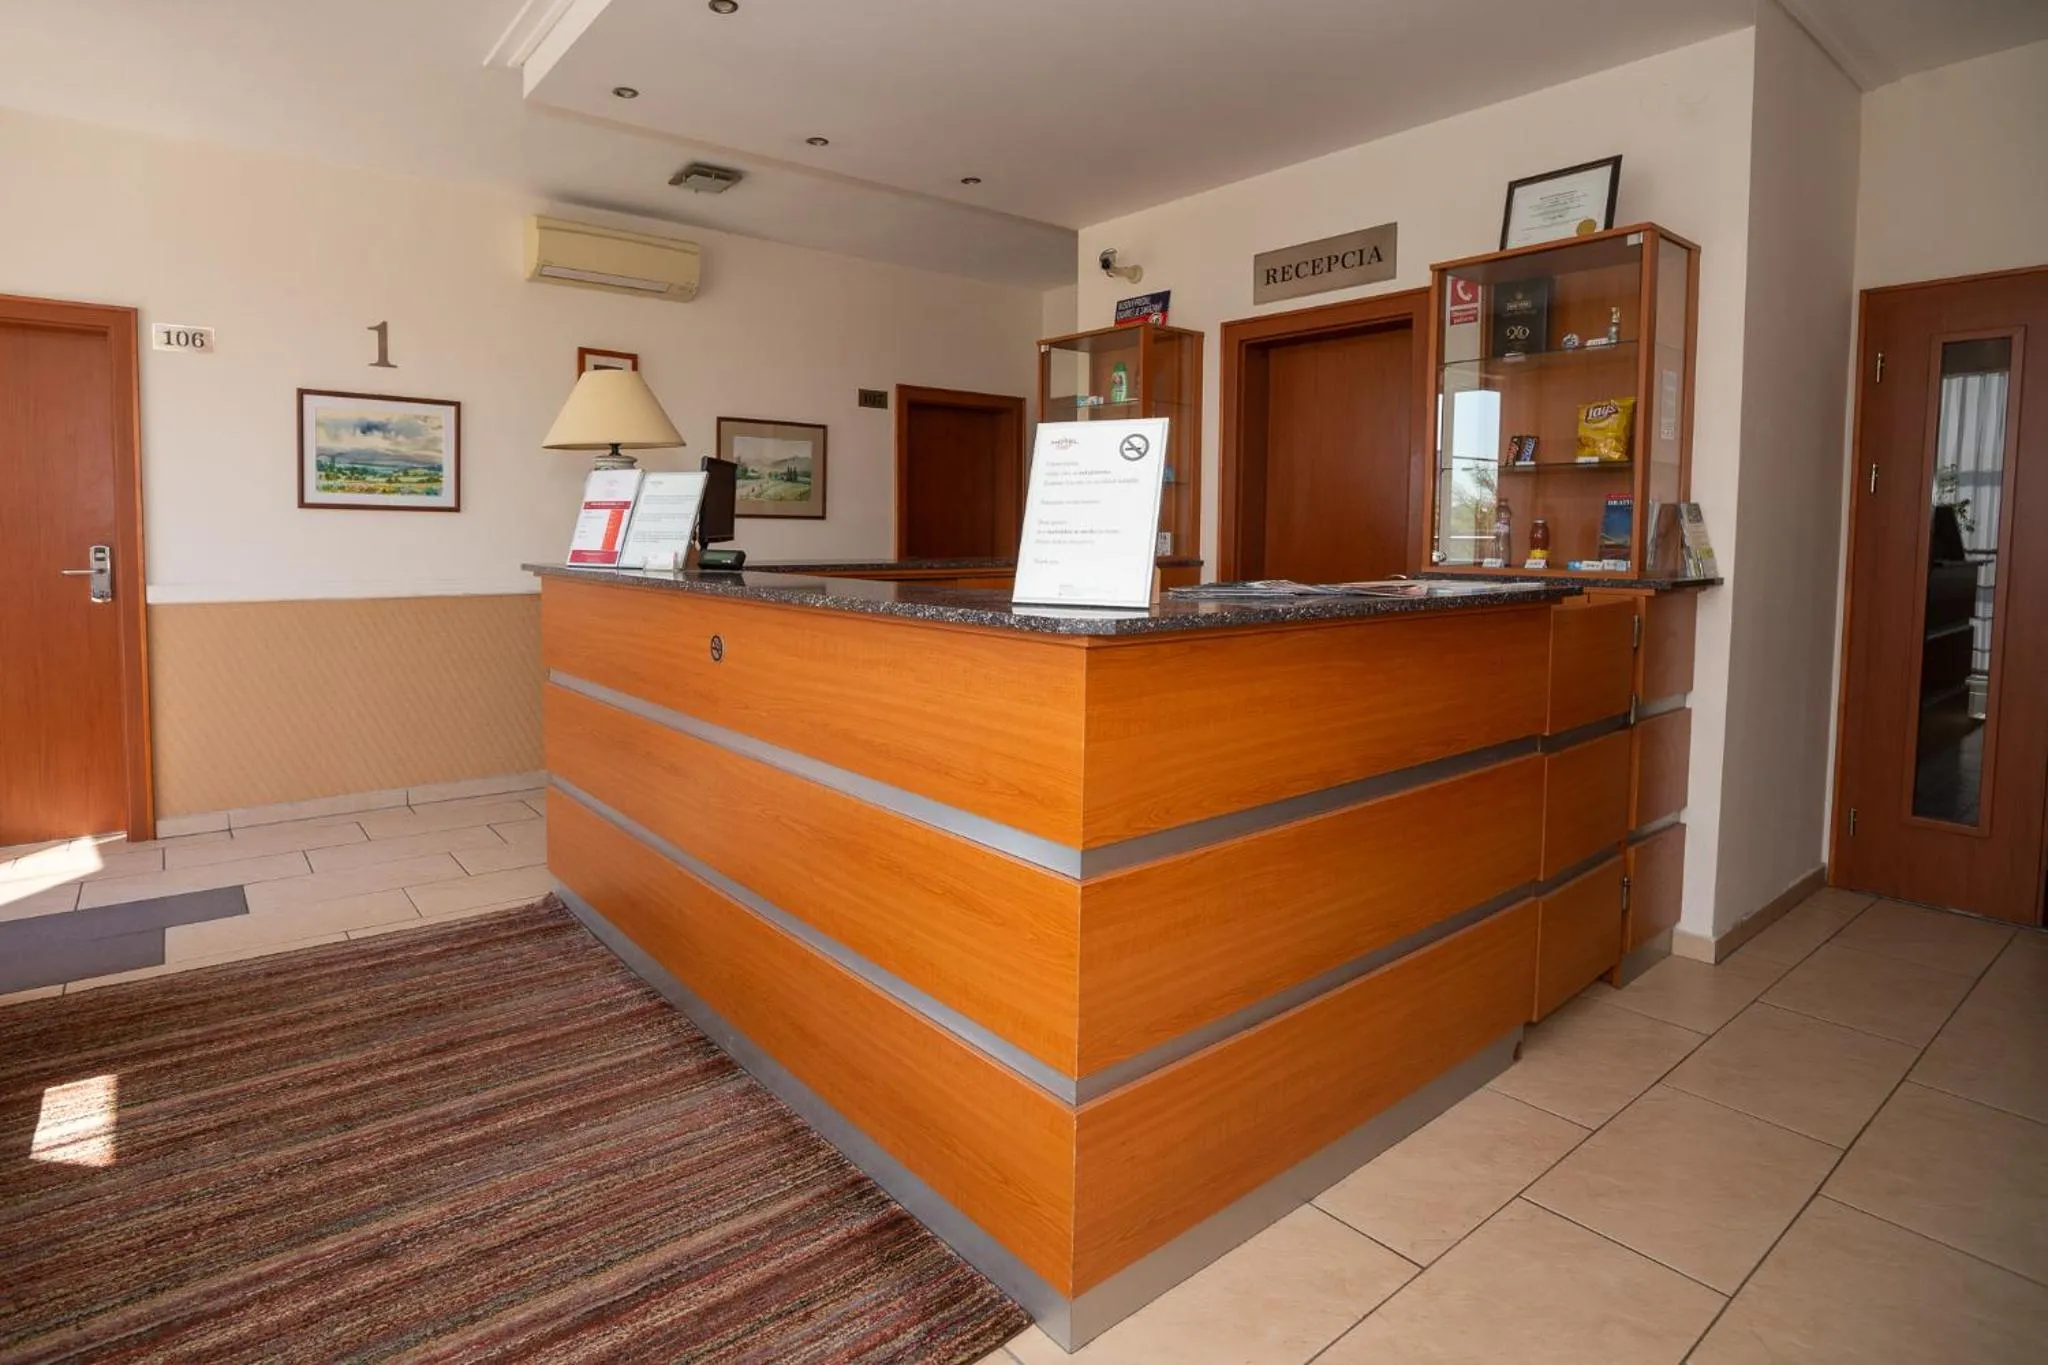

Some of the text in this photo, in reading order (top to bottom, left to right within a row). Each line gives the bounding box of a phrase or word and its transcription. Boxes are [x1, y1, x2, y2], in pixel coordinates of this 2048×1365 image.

[1264, 244, 1385, 287] RECEPCIA
[163, 329, 205, 349] 106
[367, 321, 398, 368] 1
